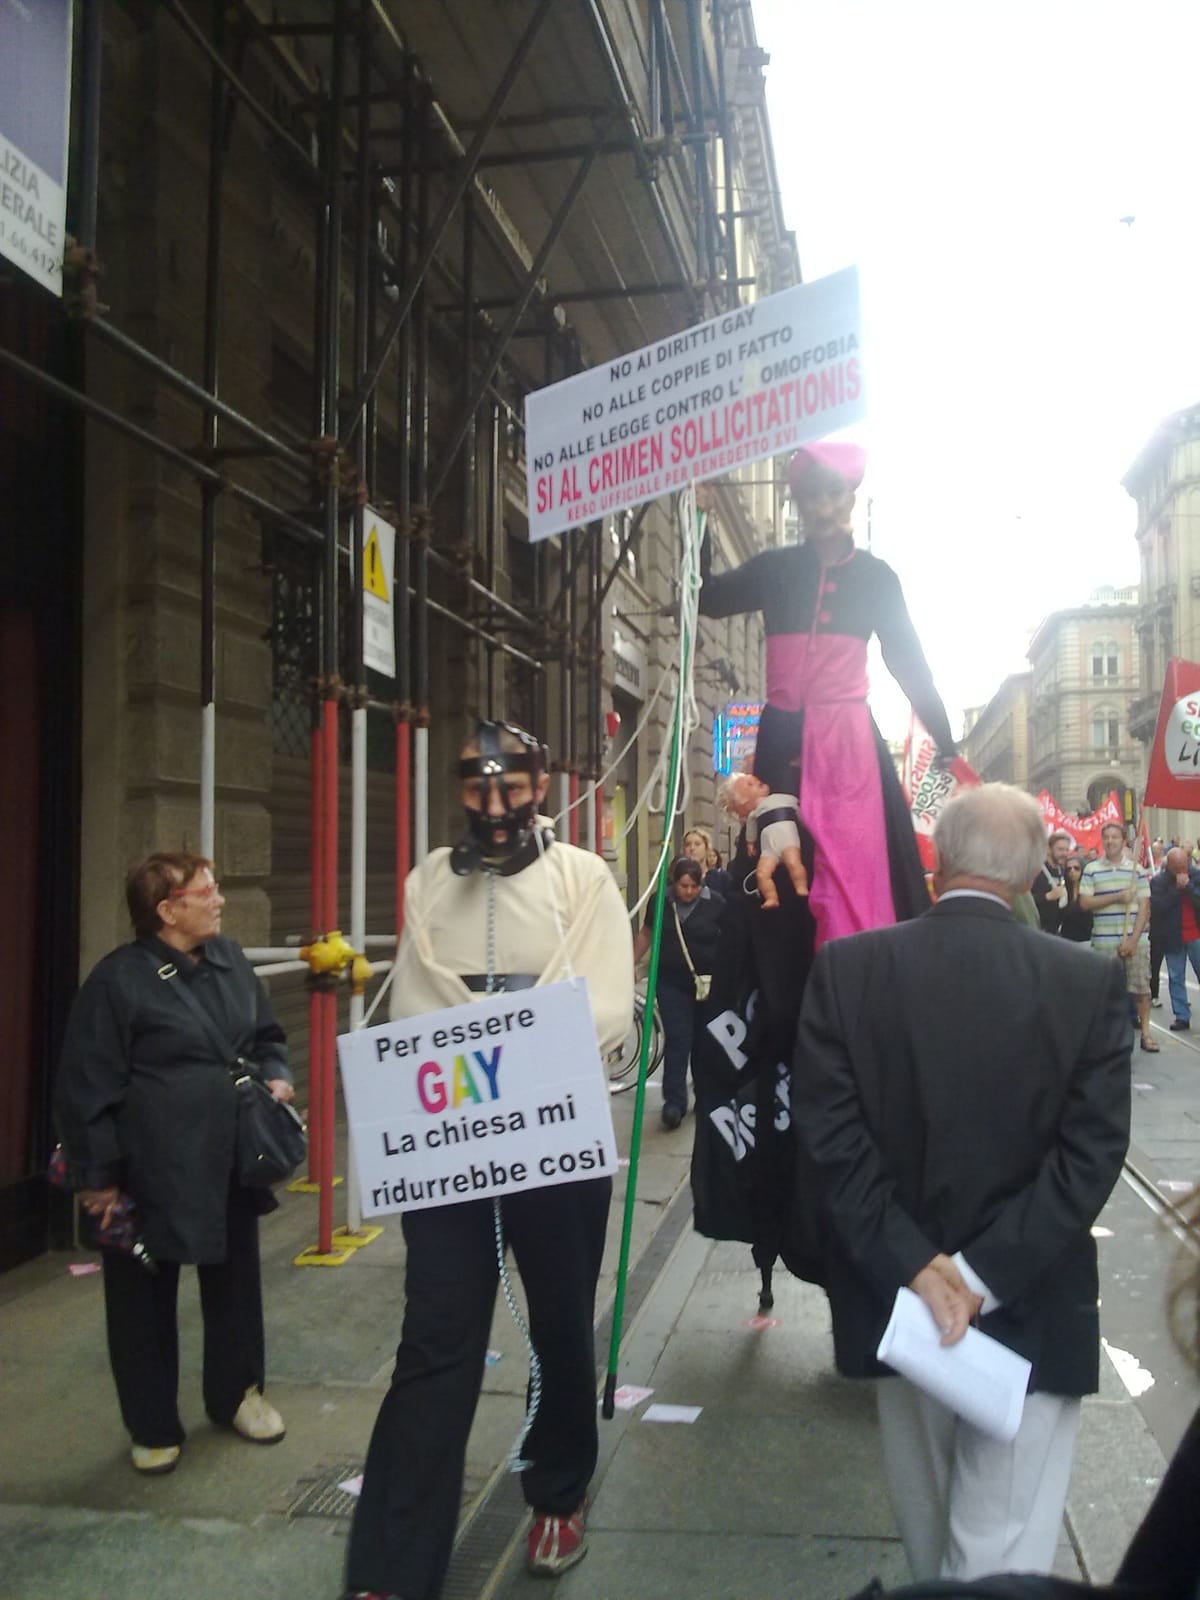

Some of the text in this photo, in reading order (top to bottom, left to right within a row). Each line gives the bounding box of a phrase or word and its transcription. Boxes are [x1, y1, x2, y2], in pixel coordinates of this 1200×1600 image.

[0, 181, 57, 247] ERALE
[582, 325, 793, 424] NO ALLE COPPIE DI FATTO
[610, 307, 756, 383] NO AI DIRITTI GAY
[534, 451, 553, 472] NO
[559, 435, 595, 463] ALLE
[600, 414, 649, 447] LEGGE
[655, 385, 723, 431] CONTRO
[760, 333, 859, 384] OMOFOBIA
[537, 356, 861, 514] SI AL CRIMEN SOLLICITATIONIS
[601, 475, 660, 511] UFFICIALE
[665, 466, 688, 489] PER
[693, 437, 769, 478] BENEDETTO
[774, 426, 797, 448] XVI
[375, 1008, 535, 1062] Per essere
[416, 1044, 503, 1114] GAY
[383, 1094, 576, 1156] La chiesa mi
[371, 1140, 607, 1208] ridurrebbe così
